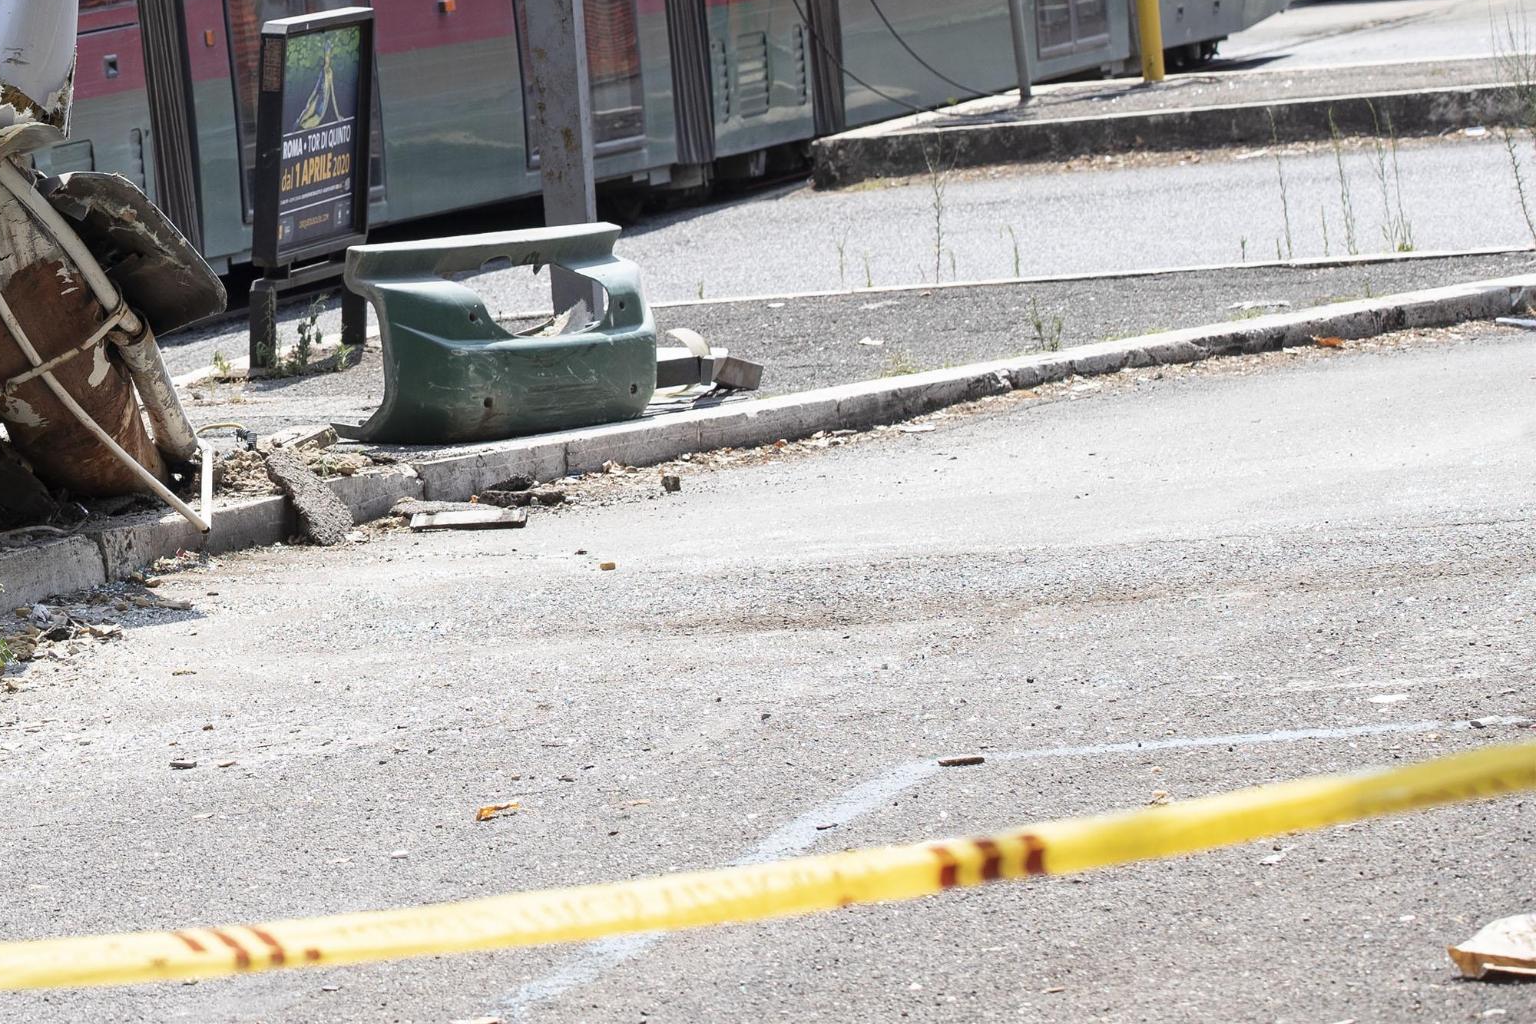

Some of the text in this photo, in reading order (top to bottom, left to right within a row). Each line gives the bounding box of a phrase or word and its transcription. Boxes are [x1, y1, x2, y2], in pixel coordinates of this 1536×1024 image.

[283, 125, 352, 160] ROMA TOR DI QUINTO
[281, 152, 351, 192] dal 1 APRILE 2020
